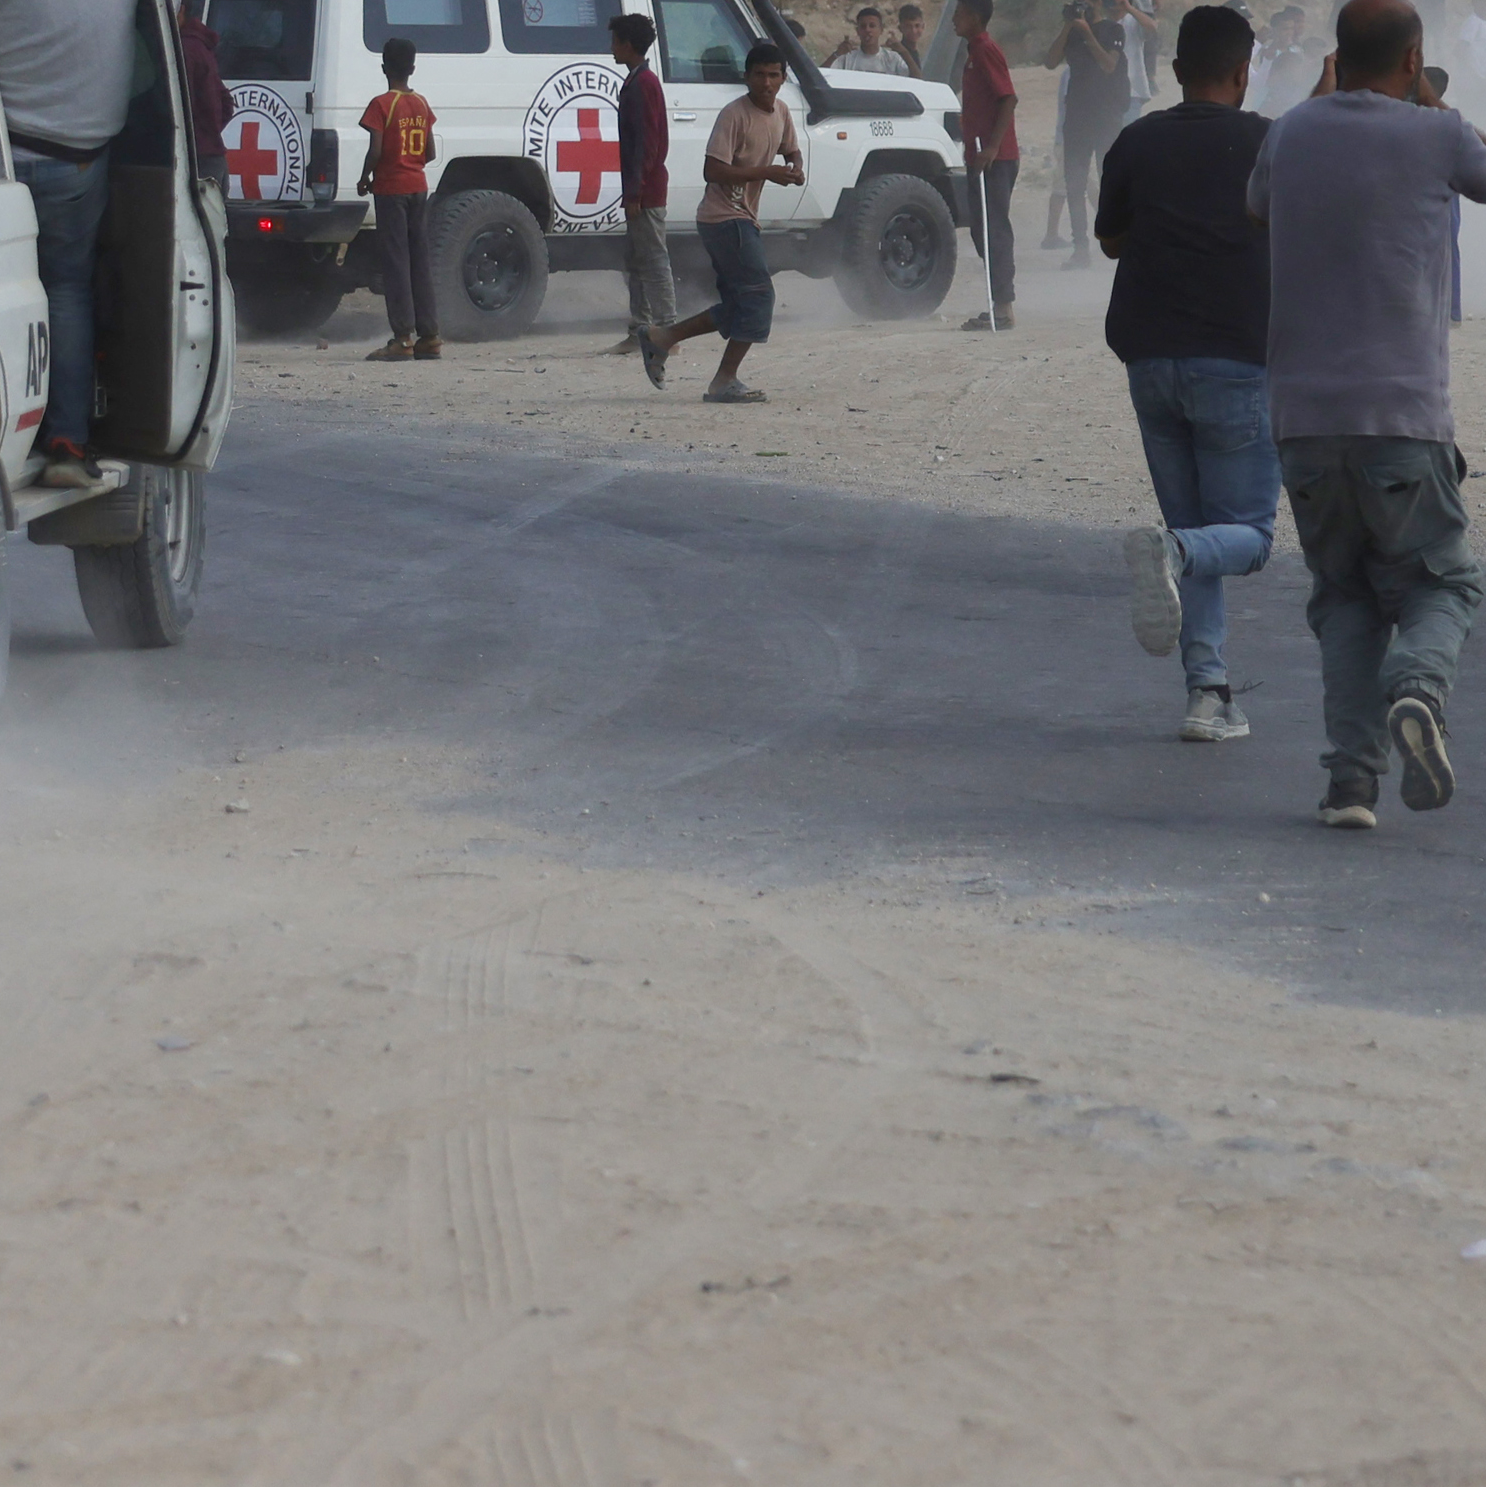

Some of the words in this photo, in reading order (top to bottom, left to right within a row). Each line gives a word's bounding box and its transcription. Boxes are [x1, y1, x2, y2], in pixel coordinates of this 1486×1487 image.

[232, 90, 301, 195] NTERNATIONAL
[400, 129, 425, 156] 10
[529, 97, 554, 158] MITE
[25, 321, 49, 399] AP
